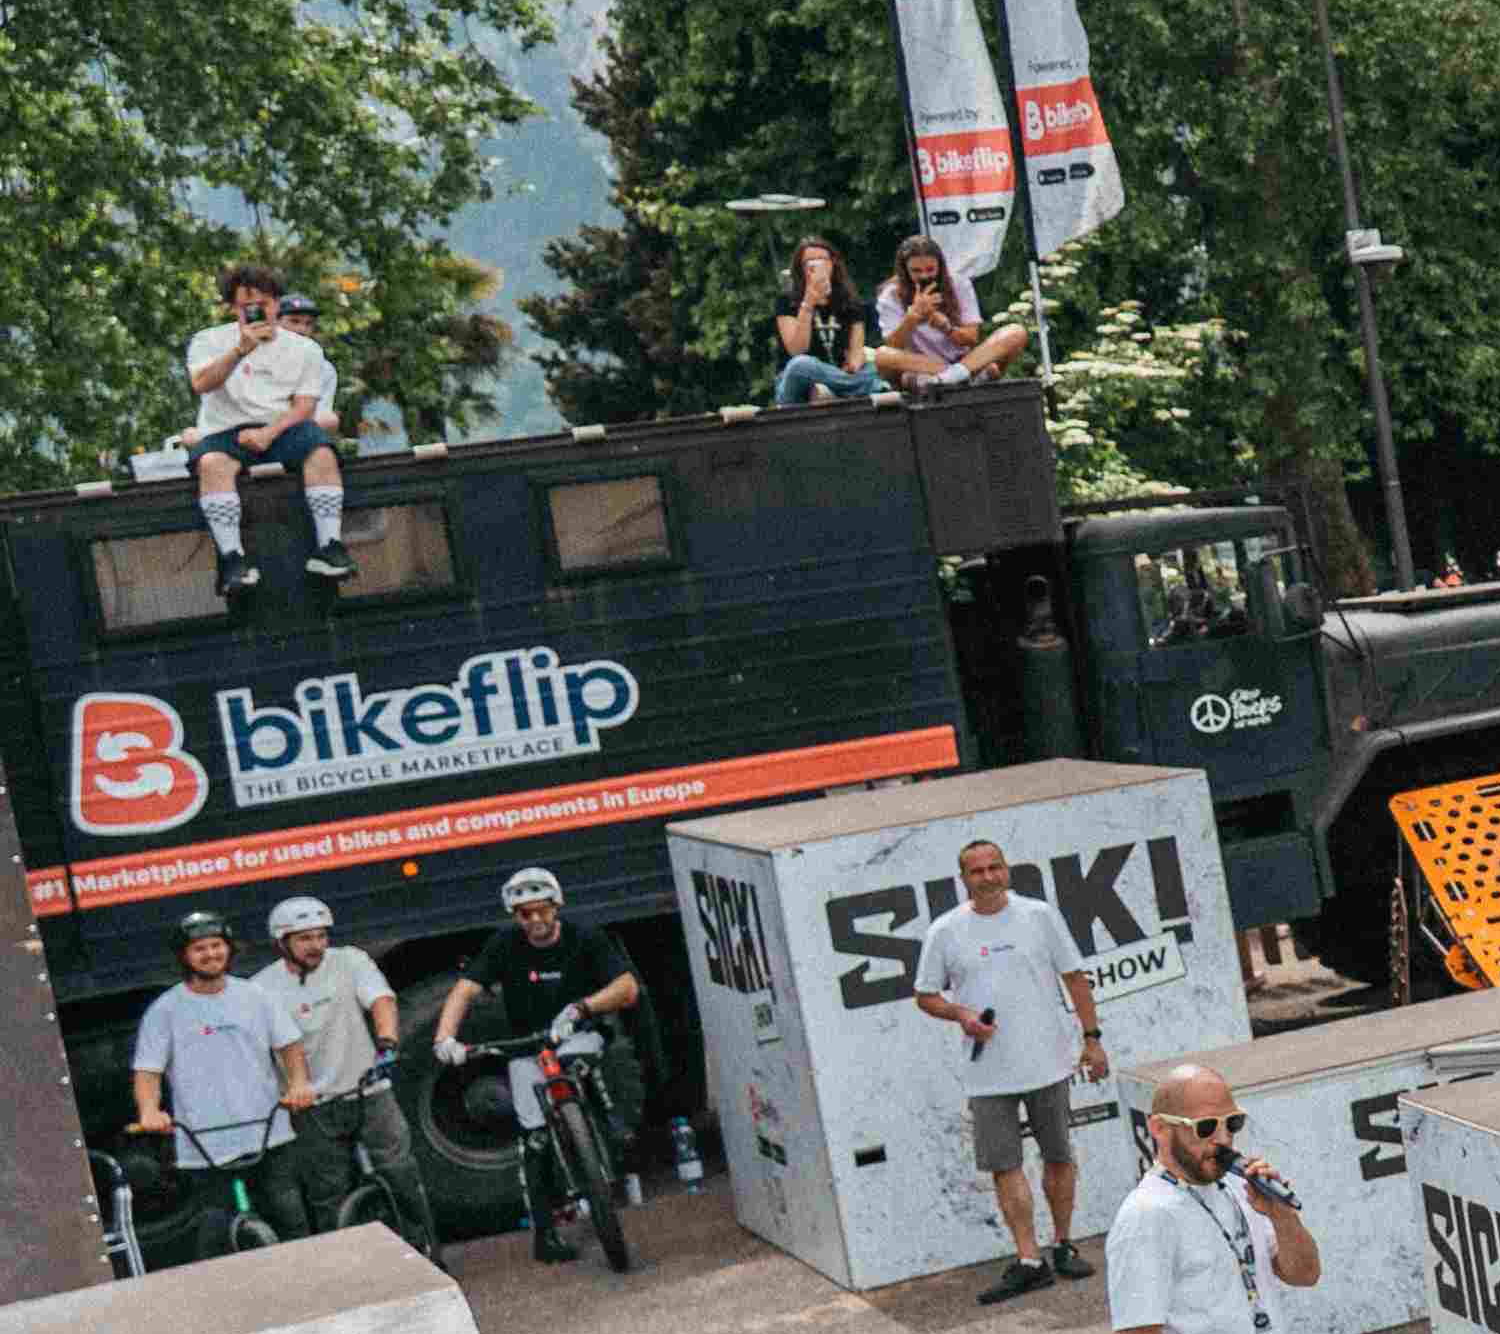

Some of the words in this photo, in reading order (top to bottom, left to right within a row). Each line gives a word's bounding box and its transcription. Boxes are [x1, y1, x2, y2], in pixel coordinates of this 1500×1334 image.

[935, 146, 1009, 173] bikeflip
[227, 652, 631, 772] bikeflip
[245, 781, 289, 800] THE
[296, 765, 391, 794] BICYCLE
[401, 737, 565, 777] MARKETPLACE
[32, 877, 66, 903] #1
[73, 855, 230, 894] Marketplace
[234, 844, 268, 868] for
[272, 835, 333, 865] used
[337, 825, 401, 853] bikes
[407, 817, 449, 845] and
[455, 796, 598, 835] components
[602, 792, 624, 810] in
[627, 777, 706, 807] Europe
[826, 835, 1194, 1010] SK!
